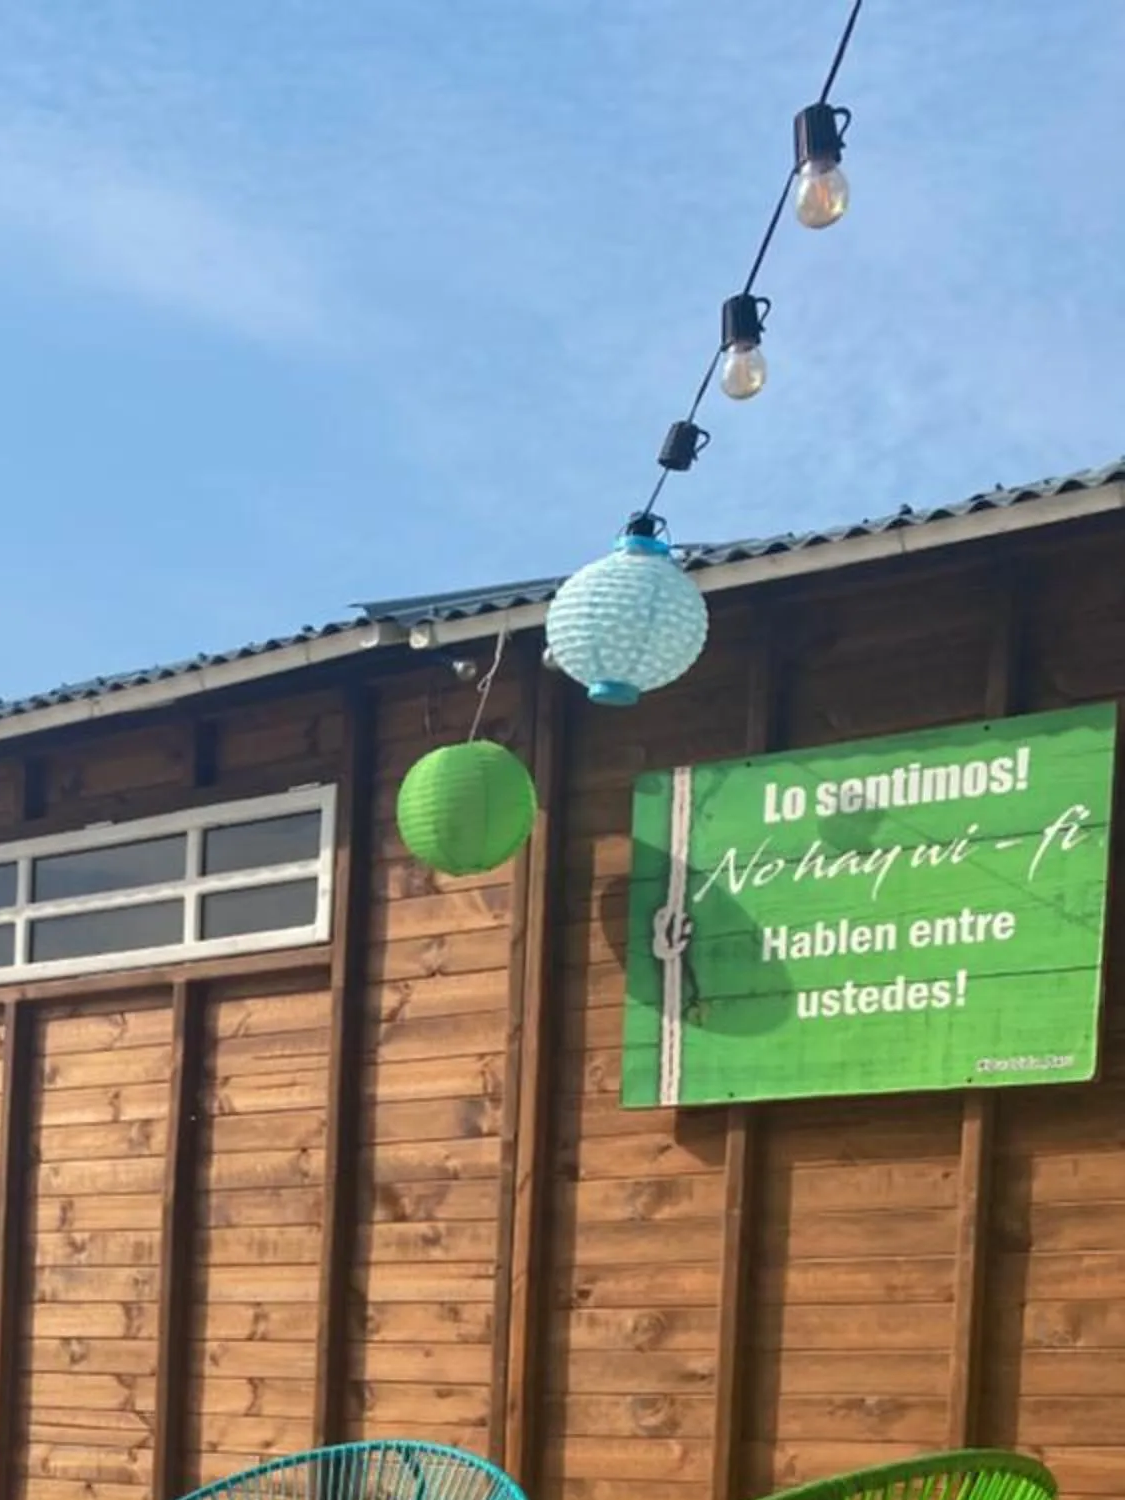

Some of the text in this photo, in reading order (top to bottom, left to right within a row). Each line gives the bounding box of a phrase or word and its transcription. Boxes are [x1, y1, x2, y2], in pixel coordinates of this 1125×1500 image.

[765, 747, 1030, 823] Lo sentimos!
[693, 837, 783, 902] No
[794, 840, 902, 900] hay
[763, 907, 1016, 961] Hablen entre
[797, 970, 967, 1018] ustedes!
